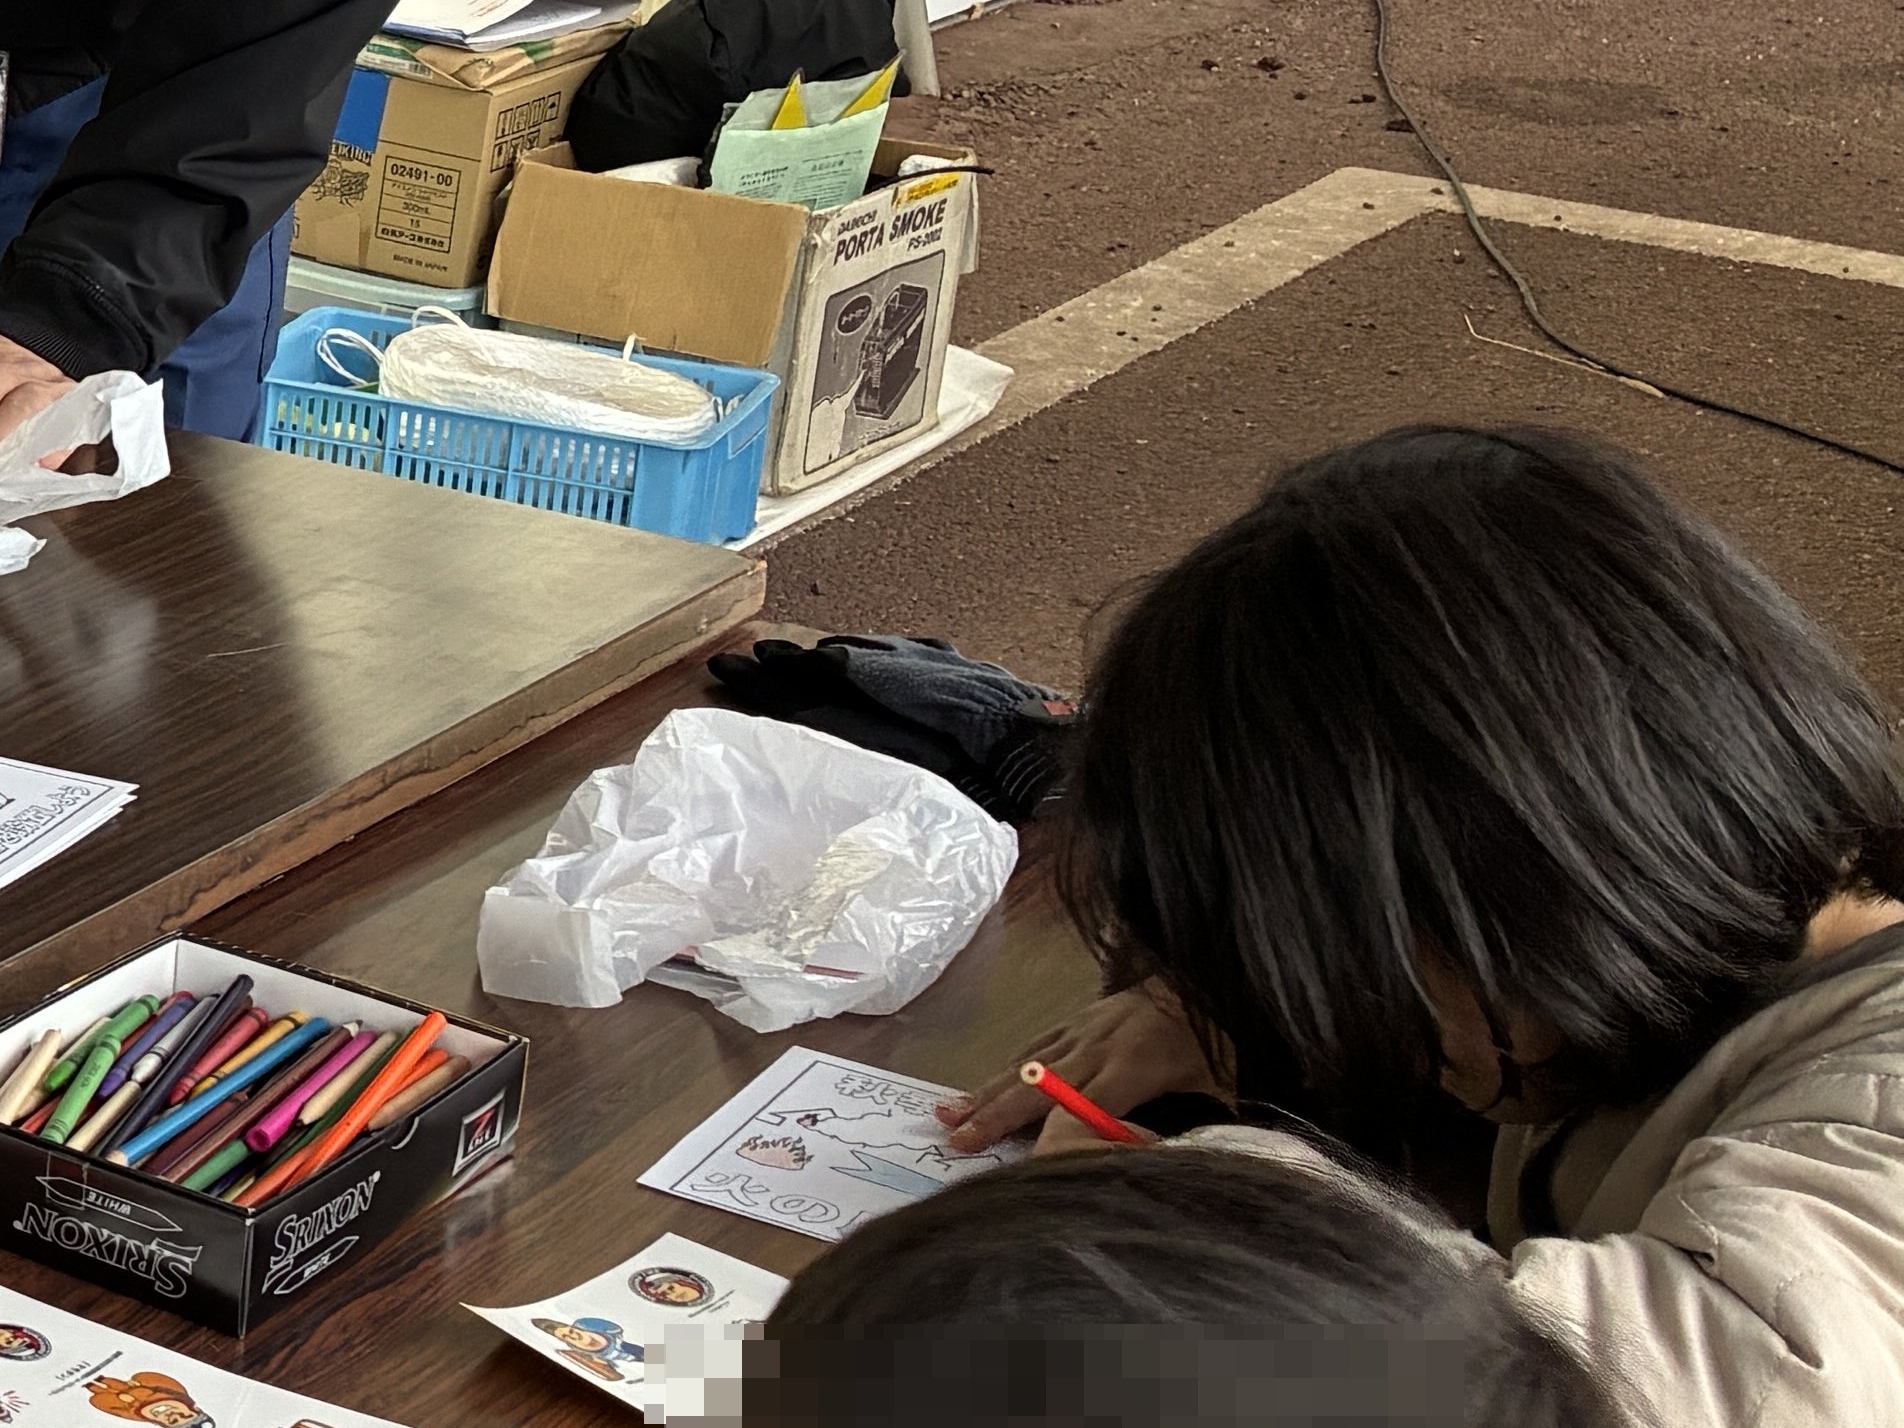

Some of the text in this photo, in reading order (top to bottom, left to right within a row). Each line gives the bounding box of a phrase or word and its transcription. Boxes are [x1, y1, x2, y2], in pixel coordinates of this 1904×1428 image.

[390, 163, 454, 188] 02491-00
[833, 197, 949, 267] PORTA SMOKE
[87, 1189, 132, 1217] WHITE
[270, 1170, 382, 1271] SRIXON
[690, 1170, 841, 1224] 火の
[13, 1201, 203, 1299] SRIXON
